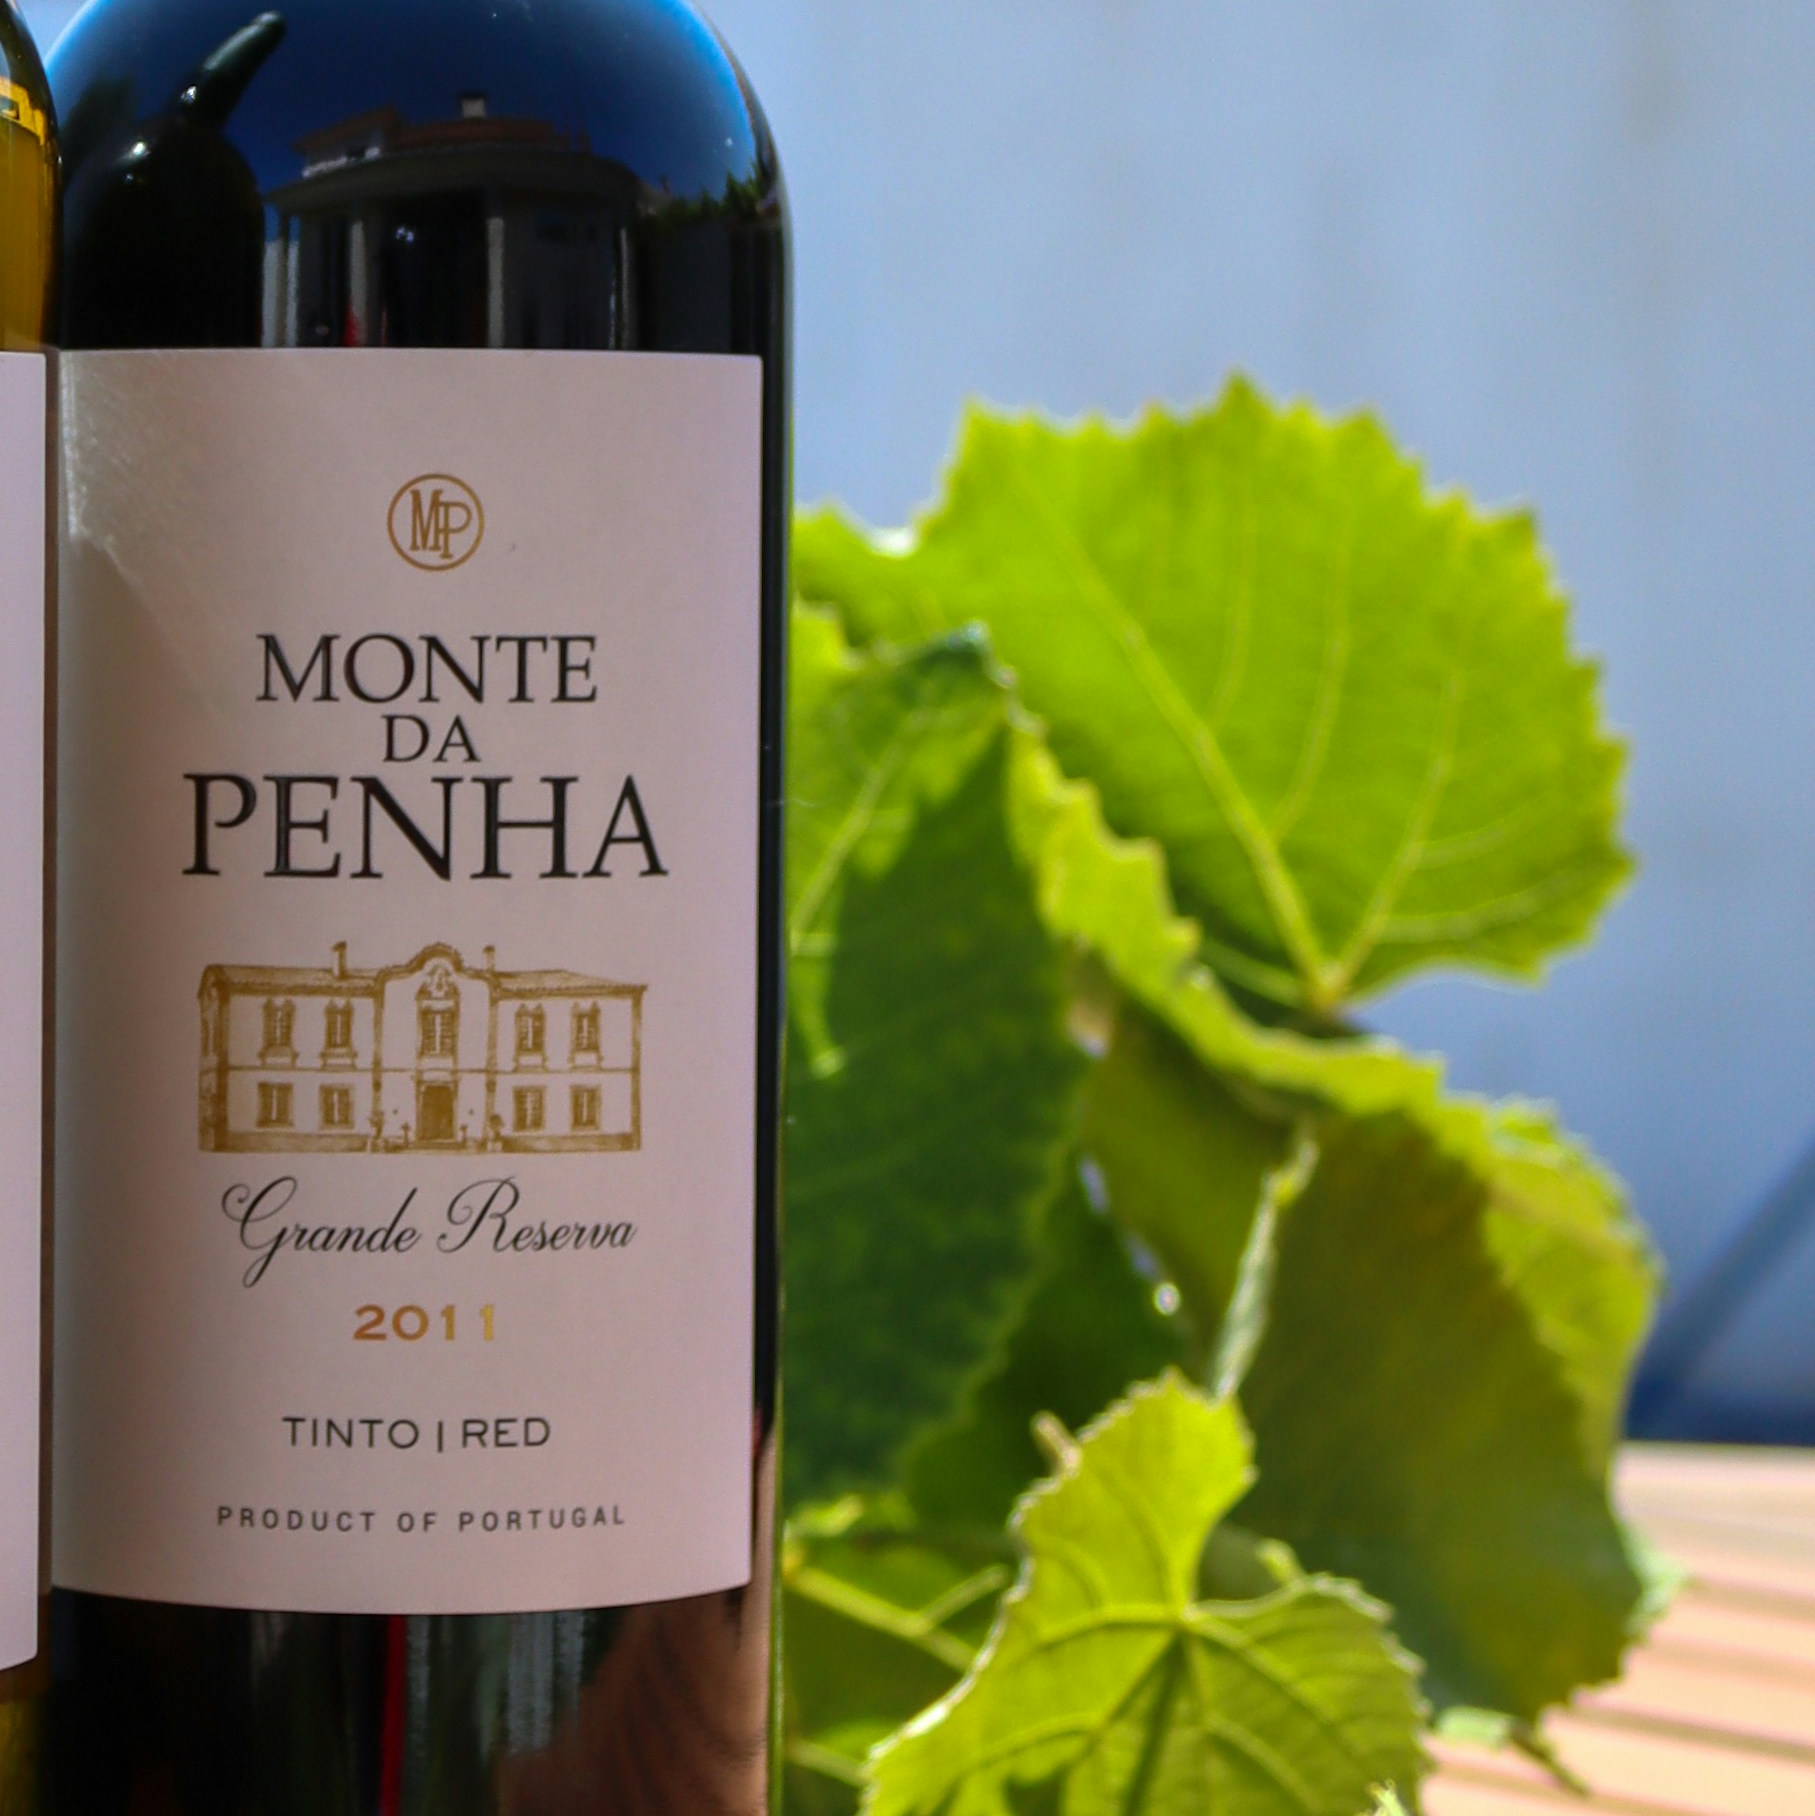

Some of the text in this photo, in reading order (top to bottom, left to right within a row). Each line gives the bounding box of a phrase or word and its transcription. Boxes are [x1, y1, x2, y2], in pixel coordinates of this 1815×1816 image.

[255, 633, 597, 704] MONTE
[381, 714, 481, 763] DA
[182, 773, 669, 882] PENHA
[220, 1175, 637, 1289] Grande Reserva
[353, 1304, 495, 1342] 2011
[281, 1415, 421, 1450] TINTO
[461, 1415, 552, 1450] RED
[216, 1504, 625, 1534] PRODUCT OF PORTUGAL
